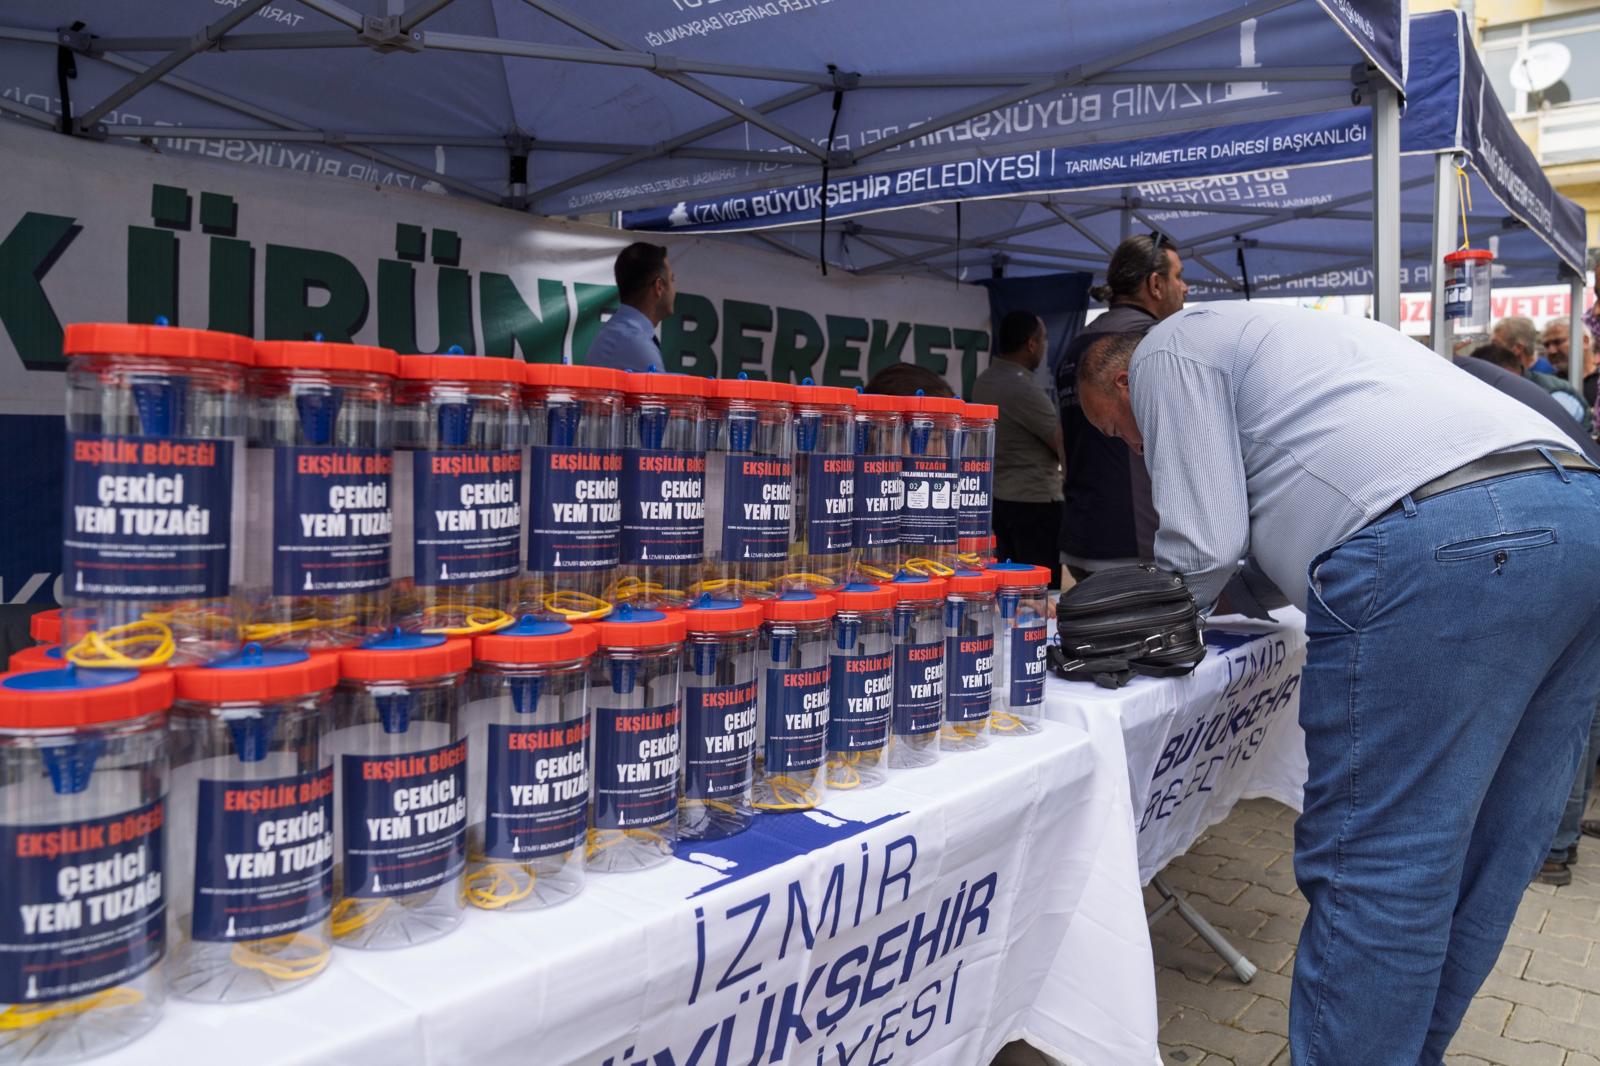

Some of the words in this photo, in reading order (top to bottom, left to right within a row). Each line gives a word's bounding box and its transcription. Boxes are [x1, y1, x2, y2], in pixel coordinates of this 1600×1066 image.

[693, 197, 750, 224] İZMİR
[751, 175, 890, 217] BÜYÜKŞEHİR
[895, 150, 1041, 194] BELEDİYESİ
[1065, 156, 1126, 175] TARIMSAL
[1130, 146, 1207, 168] HİZMETLER
[1210, 136, 1269, 158] DAİRESİ
[1272, 124, 1367, 152] BAŞKANLIĞI
[661, 292, 990, 403] BEREKET
[74, 438, 138, 466] EKŞİLİK
[143, 440, 216, 467] BÖCEĞİ
[551, 452, 601, 473] EKŞİLİK
[297, 452, 363, 478] EKŞİLİK
[431, 453, 490, 478] EKŞİLİK
[639, 456, 685, 474] EKŞİLİK
[743, 460, 781, 477] EKŞİLİK
[864, 459, 896, 475] EKŞİLİK
[915, 461, 947, 471] TUZAĞIN
[98, 472, 184, 507] ÇEKİCİ
[460, 479, 514, 510] ÇEKİCİ
[575, 477, 618, 503] ÇEKİCİ
[661, 478, 702, 502] ÇEKİCİ
[909, 482, 918, 490] 02
[329, 482, 387, 513] ÇEKİCİ
[825, 498, 847, 514] YEM
[866, 497, 888, 512] YEM
[75, 505, 117, 534] YEM
[120, 504, 210, 536] TUZAĞI
[435, 509, 477, 531] YEM
[552, 503, 588, 522] YEM
[640, 501, 673, 520] YEM
[744, 503, 771, 520] YEM
[300, 513, 347, 537] YEM
[909, 646, 939, 662] EKŞİLİK
[961, 639, 990, 654] EKŞİLİK
[846, 657, 882, 675] EKŞİLİK
[1025, 661, 1042, 675] YEM
[784, 671, 821, 689] EKŞİLİK
[910, 683, 931, 699] YEM
[962, 674, 983, 689] YEM
[703, 688, 744, 709] EKŞİLİK
[848, 697, 873, 713] YEM
[616, 712, 663, 734] EKŞİLİK
[785, 713, 812, 730] YEM
[509, 728, 564, 753] EKŞİLİK
[705, 734, 735, 754] YEM
[362, 755, 427, 782] EKŞİLİK
[535, 747, 585, 783] ÇEKİCİ
[617, 762, 650, 783] YEM
[224, 784, 297, 815] EKŞİLİK
[393, 774, 456, 816] ÇEKİCİ
[510, 784, 550, 806] YEM
[257, 806, 325, 852] ÇEKİCİ
[367, 816, 412, 842] YEM
[16, 825, 105, 859] EKŞİLİK
[57, 844, 146, 900] ÇEKİCİ
[225, 851, 276, 880] YEM
[20, 900, 83, 935] YEM
[87, 871, 162, 925] TUZAĞI
[688, 834, 918, 1005] İZMİR
